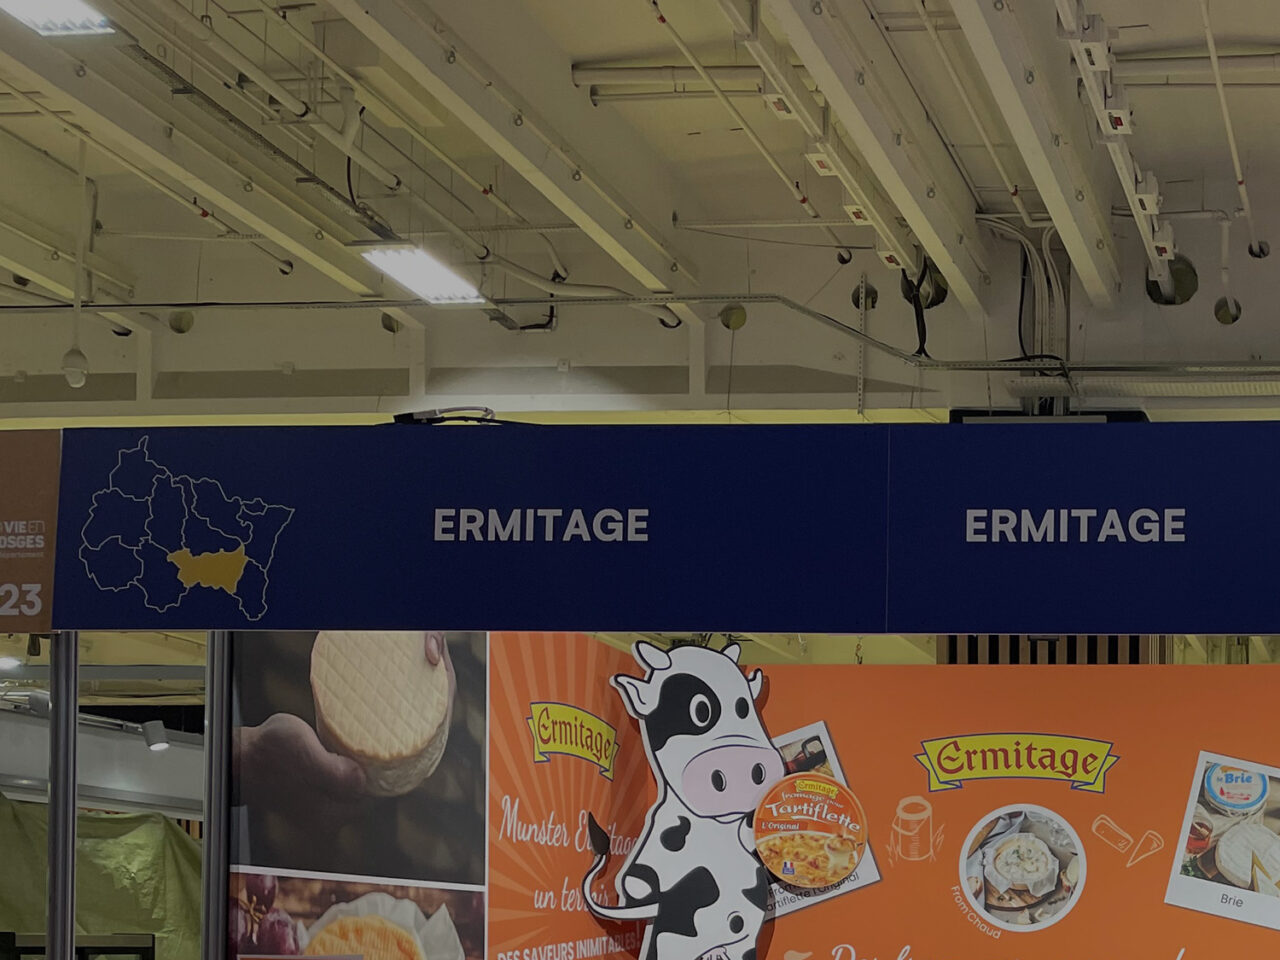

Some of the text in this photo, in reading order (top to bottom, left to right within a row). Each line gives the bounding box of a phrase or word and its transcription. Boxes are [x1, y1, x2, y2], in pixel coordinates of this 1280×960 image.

[433, 507, 650, 543] ERMITAGE
[965, 507, 1187, 543] ERMITAGE
[0, 535, 45, 549] OSGES
[0, 583, 42, 616] 23
[537, 706, 611, 762] Ermitage
[936, 740, 1099, 778] Ermitage
[1224, 772, 1253, 784] Brie
[499, 794, 571, 848] Munster
[765, 800, 861, 833] Tartiflette
[534, 887, 557, 910] un
[767, 889, 811, 912] artiflette
[1220, 893, 1244, 908] Brie
